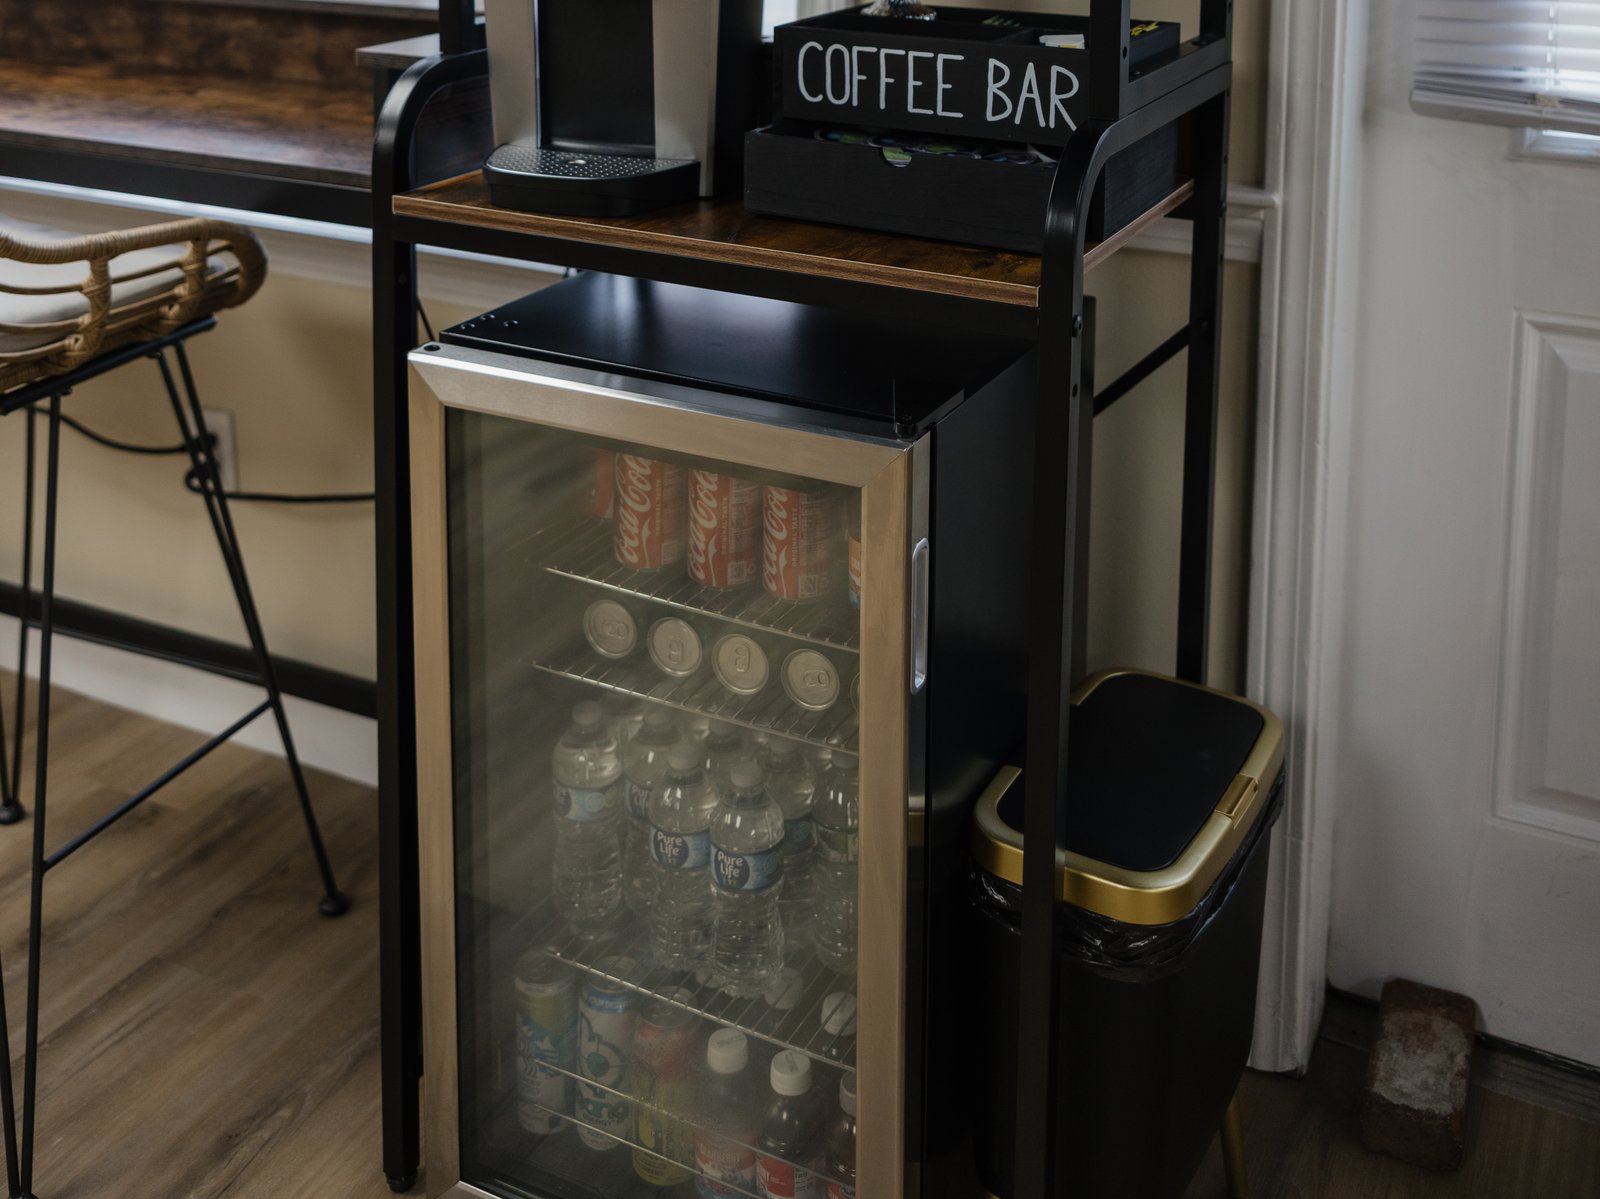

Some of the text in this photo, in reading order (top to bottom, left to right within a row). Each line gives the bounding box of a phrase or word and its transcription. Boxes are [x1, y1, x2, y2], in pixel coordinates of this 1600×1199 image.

[798, 41, 1079, 132] COFFEE BAR
[657, 831, 682, 846] Pure
[660, 841, 680, 857] Life
[717, 850, 743, 866] Pure
[720, 862, 740, 878] Life
